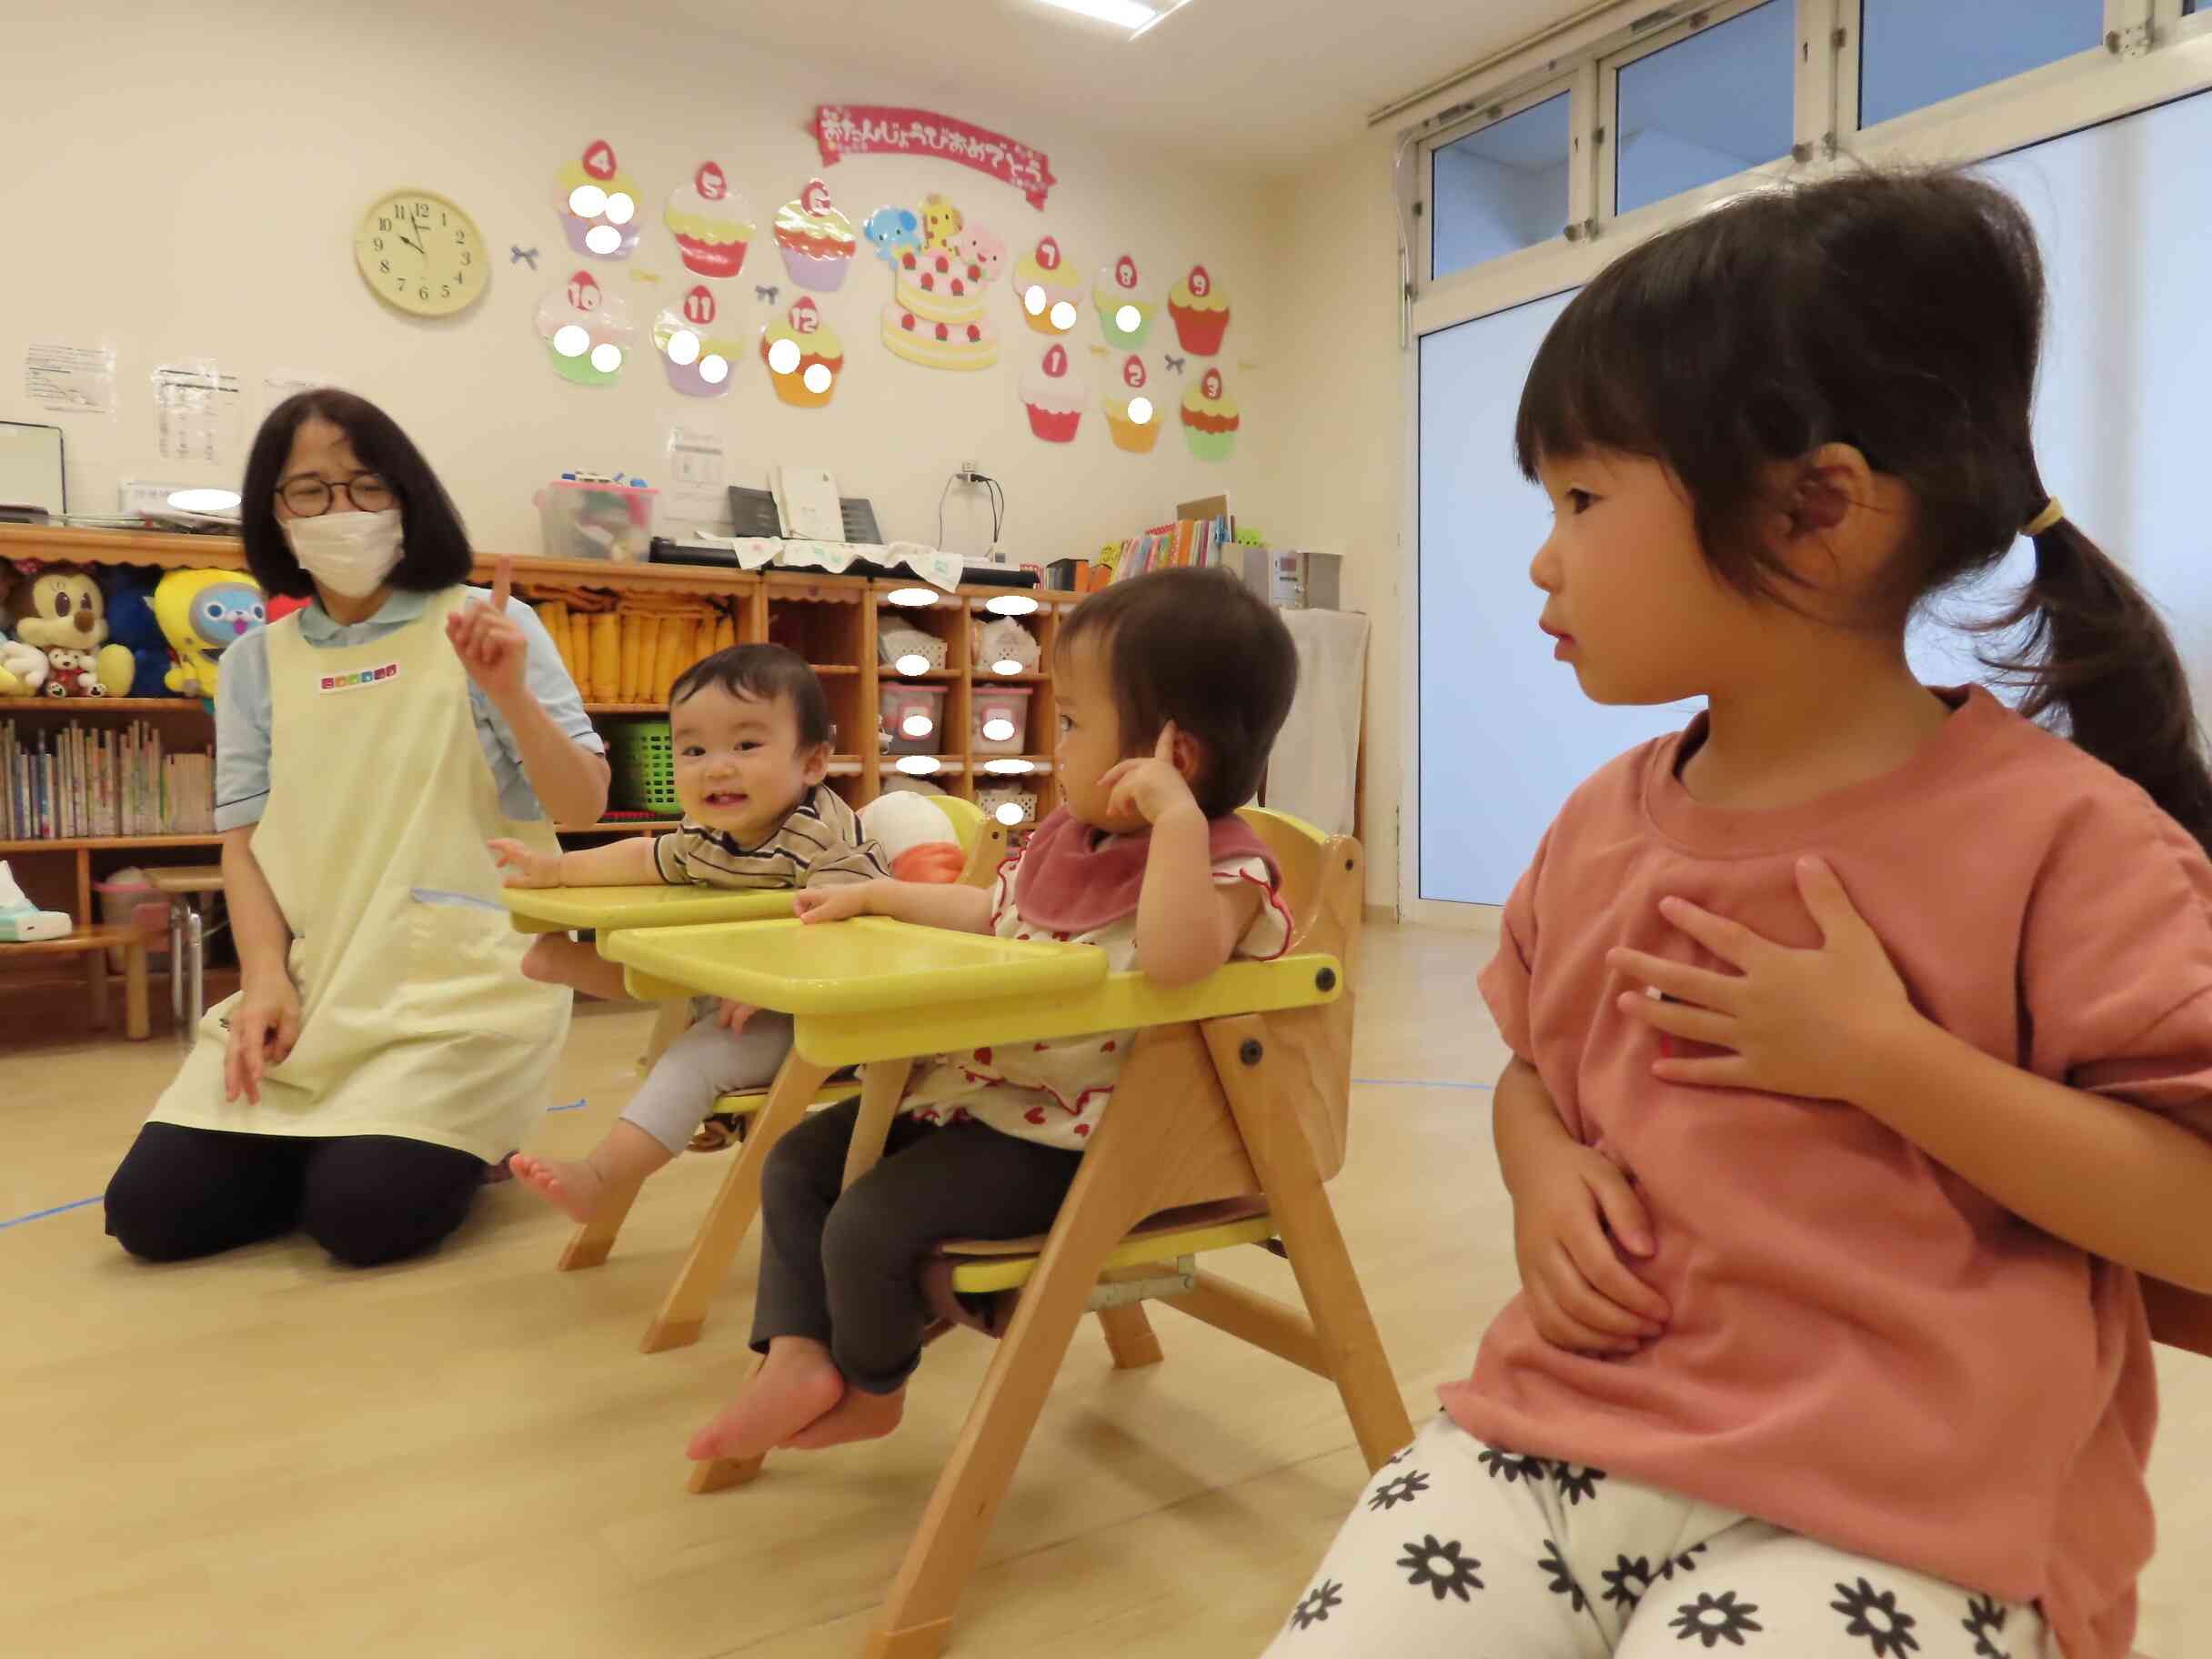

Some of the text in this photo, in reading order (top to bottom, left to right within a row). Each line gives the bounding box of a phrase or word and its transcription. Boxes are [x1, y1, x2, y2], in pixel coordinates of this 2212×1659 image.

[588, 148, 611, 173] 4
[701, 170, 722, 196] 5
[395, 205, 405, 219] 11
[415, 203, 429, 217] 12
[379, 217, 393, 232] 10
[441, 212, 447, 226] 1
[373, 237, 384, 251] 9
[456, 229, 465, 245] 2
[460, 251, 471, 266] 3
[1041, 243, 1056, 267] 7
[379, 259, 391, 274] 8
[397, 276, 407, 291] 7
[453, 271, 463, 284] 4
[1193, 274, 1206, 295] 9
[418, 286, 428, 300] 6
[440, 284, 450, 297] 5
[569, 283, 601, 309] 10
[687, 297, 711, 320] 11
[791, 307, 819, 333] 12
[1051, 351, 1061, 373] 1
[1127, 363, 1143, 387] 2
[1207, 376, 1220, 397] 3
